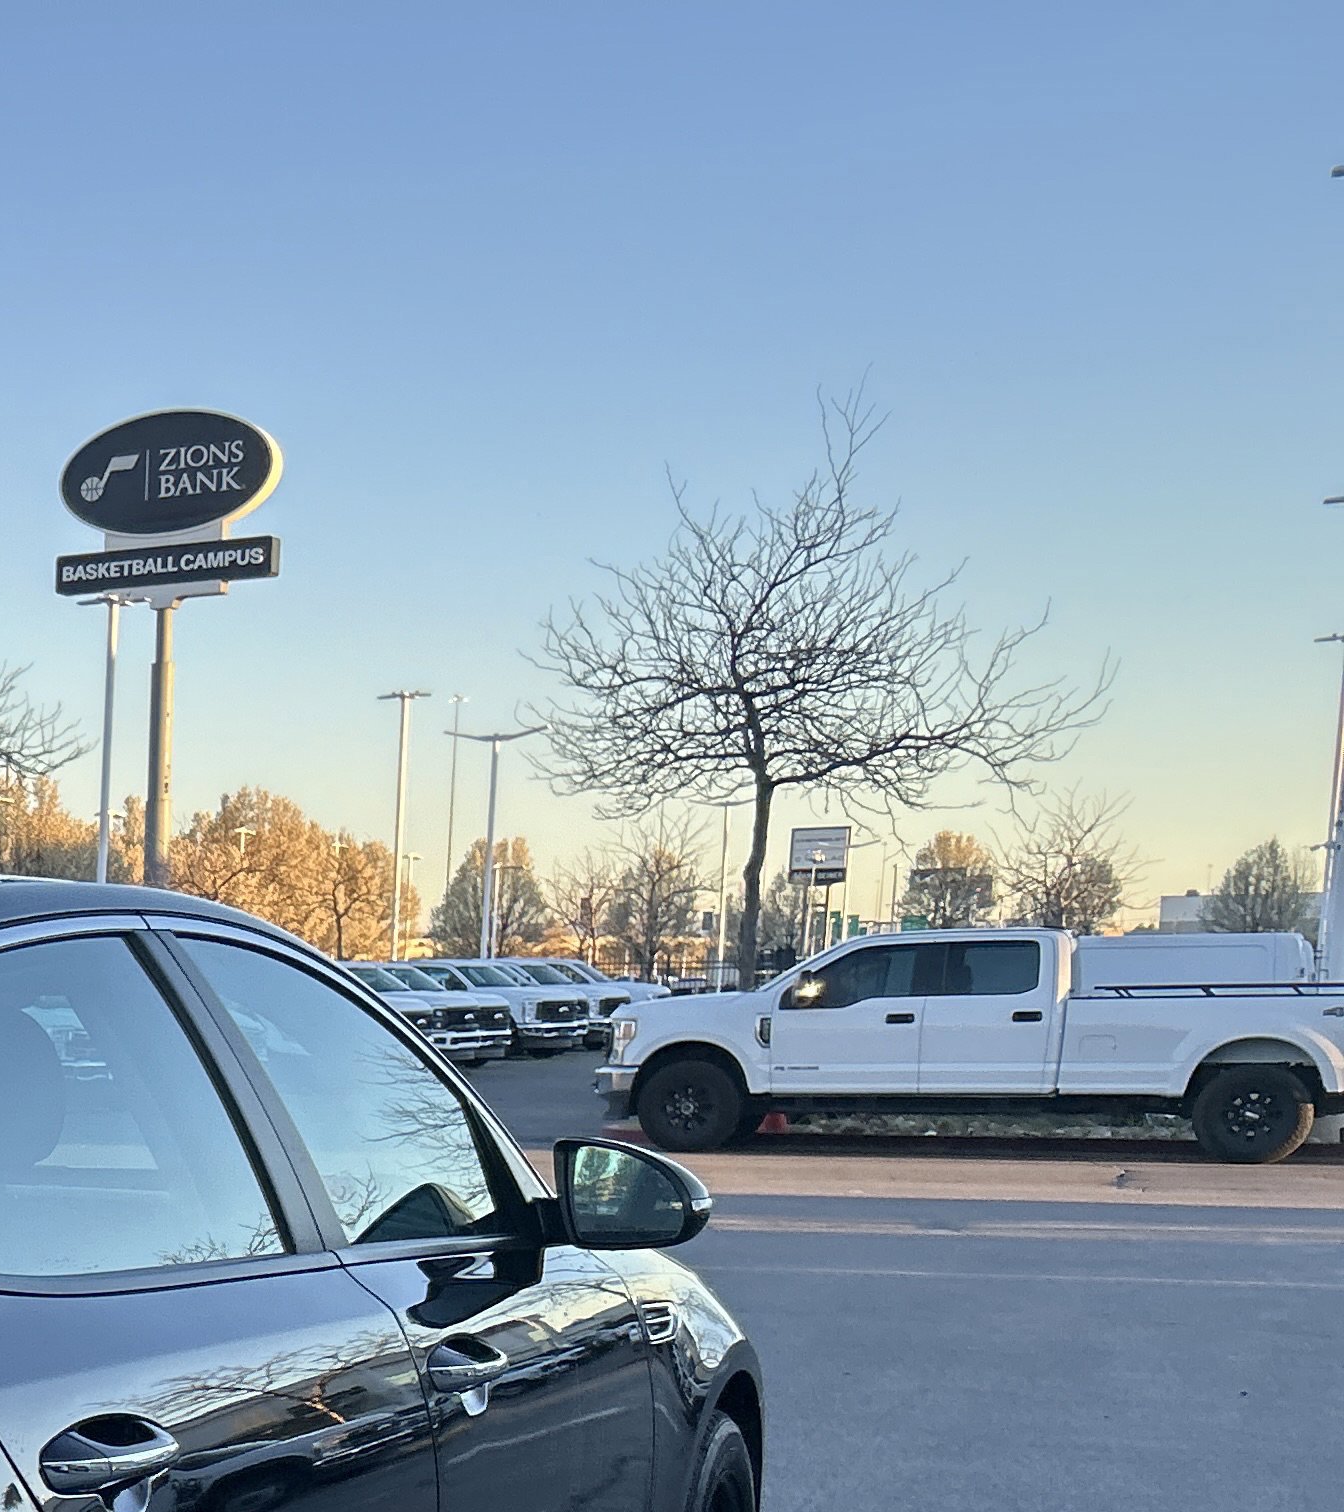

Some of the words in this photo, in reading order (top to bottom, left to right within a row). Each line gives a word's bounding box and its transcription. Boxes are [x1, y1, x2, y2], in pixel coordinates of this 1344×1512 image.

[158, 439, 245, 472] ZIONS
[157, 466, 242, 499] BANK
[62, 555, 179, 582] BASKETBALL
[180, 547, 264, 570] CAMPUS
